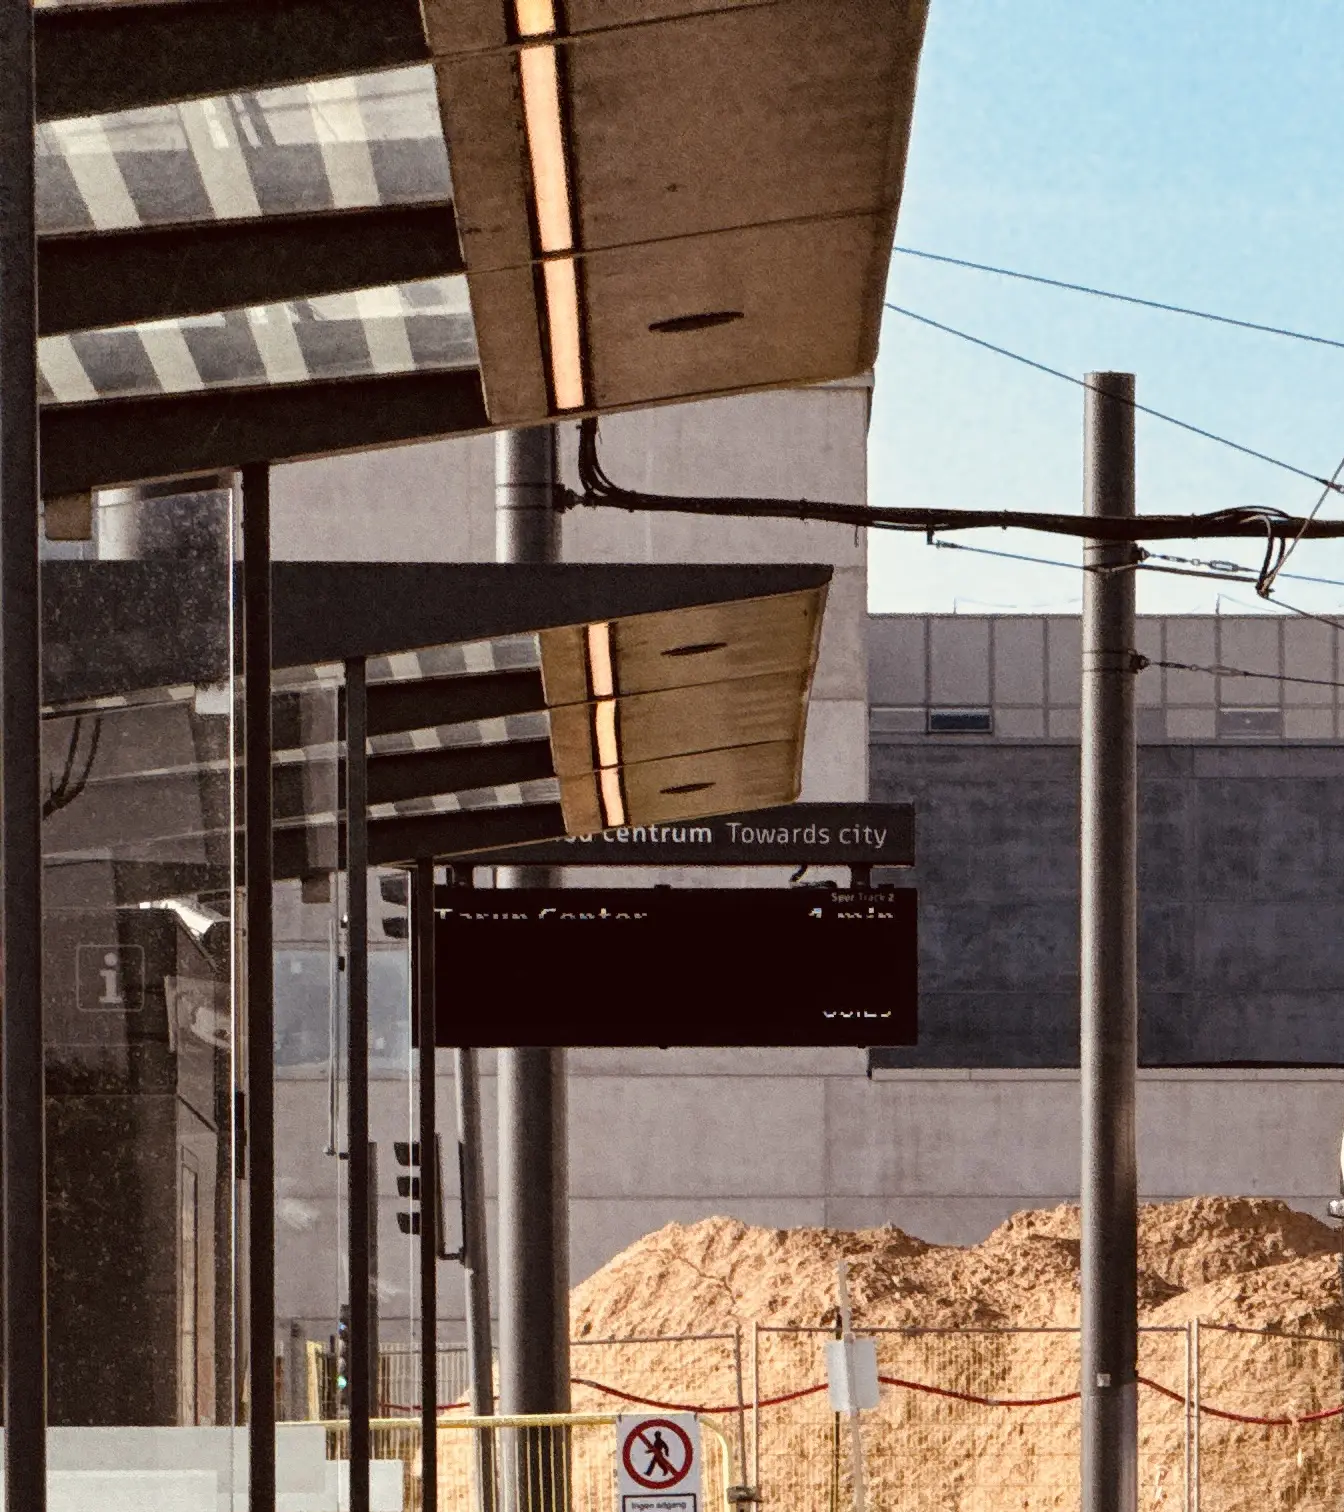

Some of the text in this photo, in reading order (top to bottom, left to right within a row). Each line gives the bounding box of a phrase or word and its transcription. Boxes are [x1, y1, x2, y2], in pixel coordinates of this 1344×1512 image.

[603, 822, 713, 844] centrum
[725, 822, 830, 844] Towards
[838, 823, 889, 849] city
